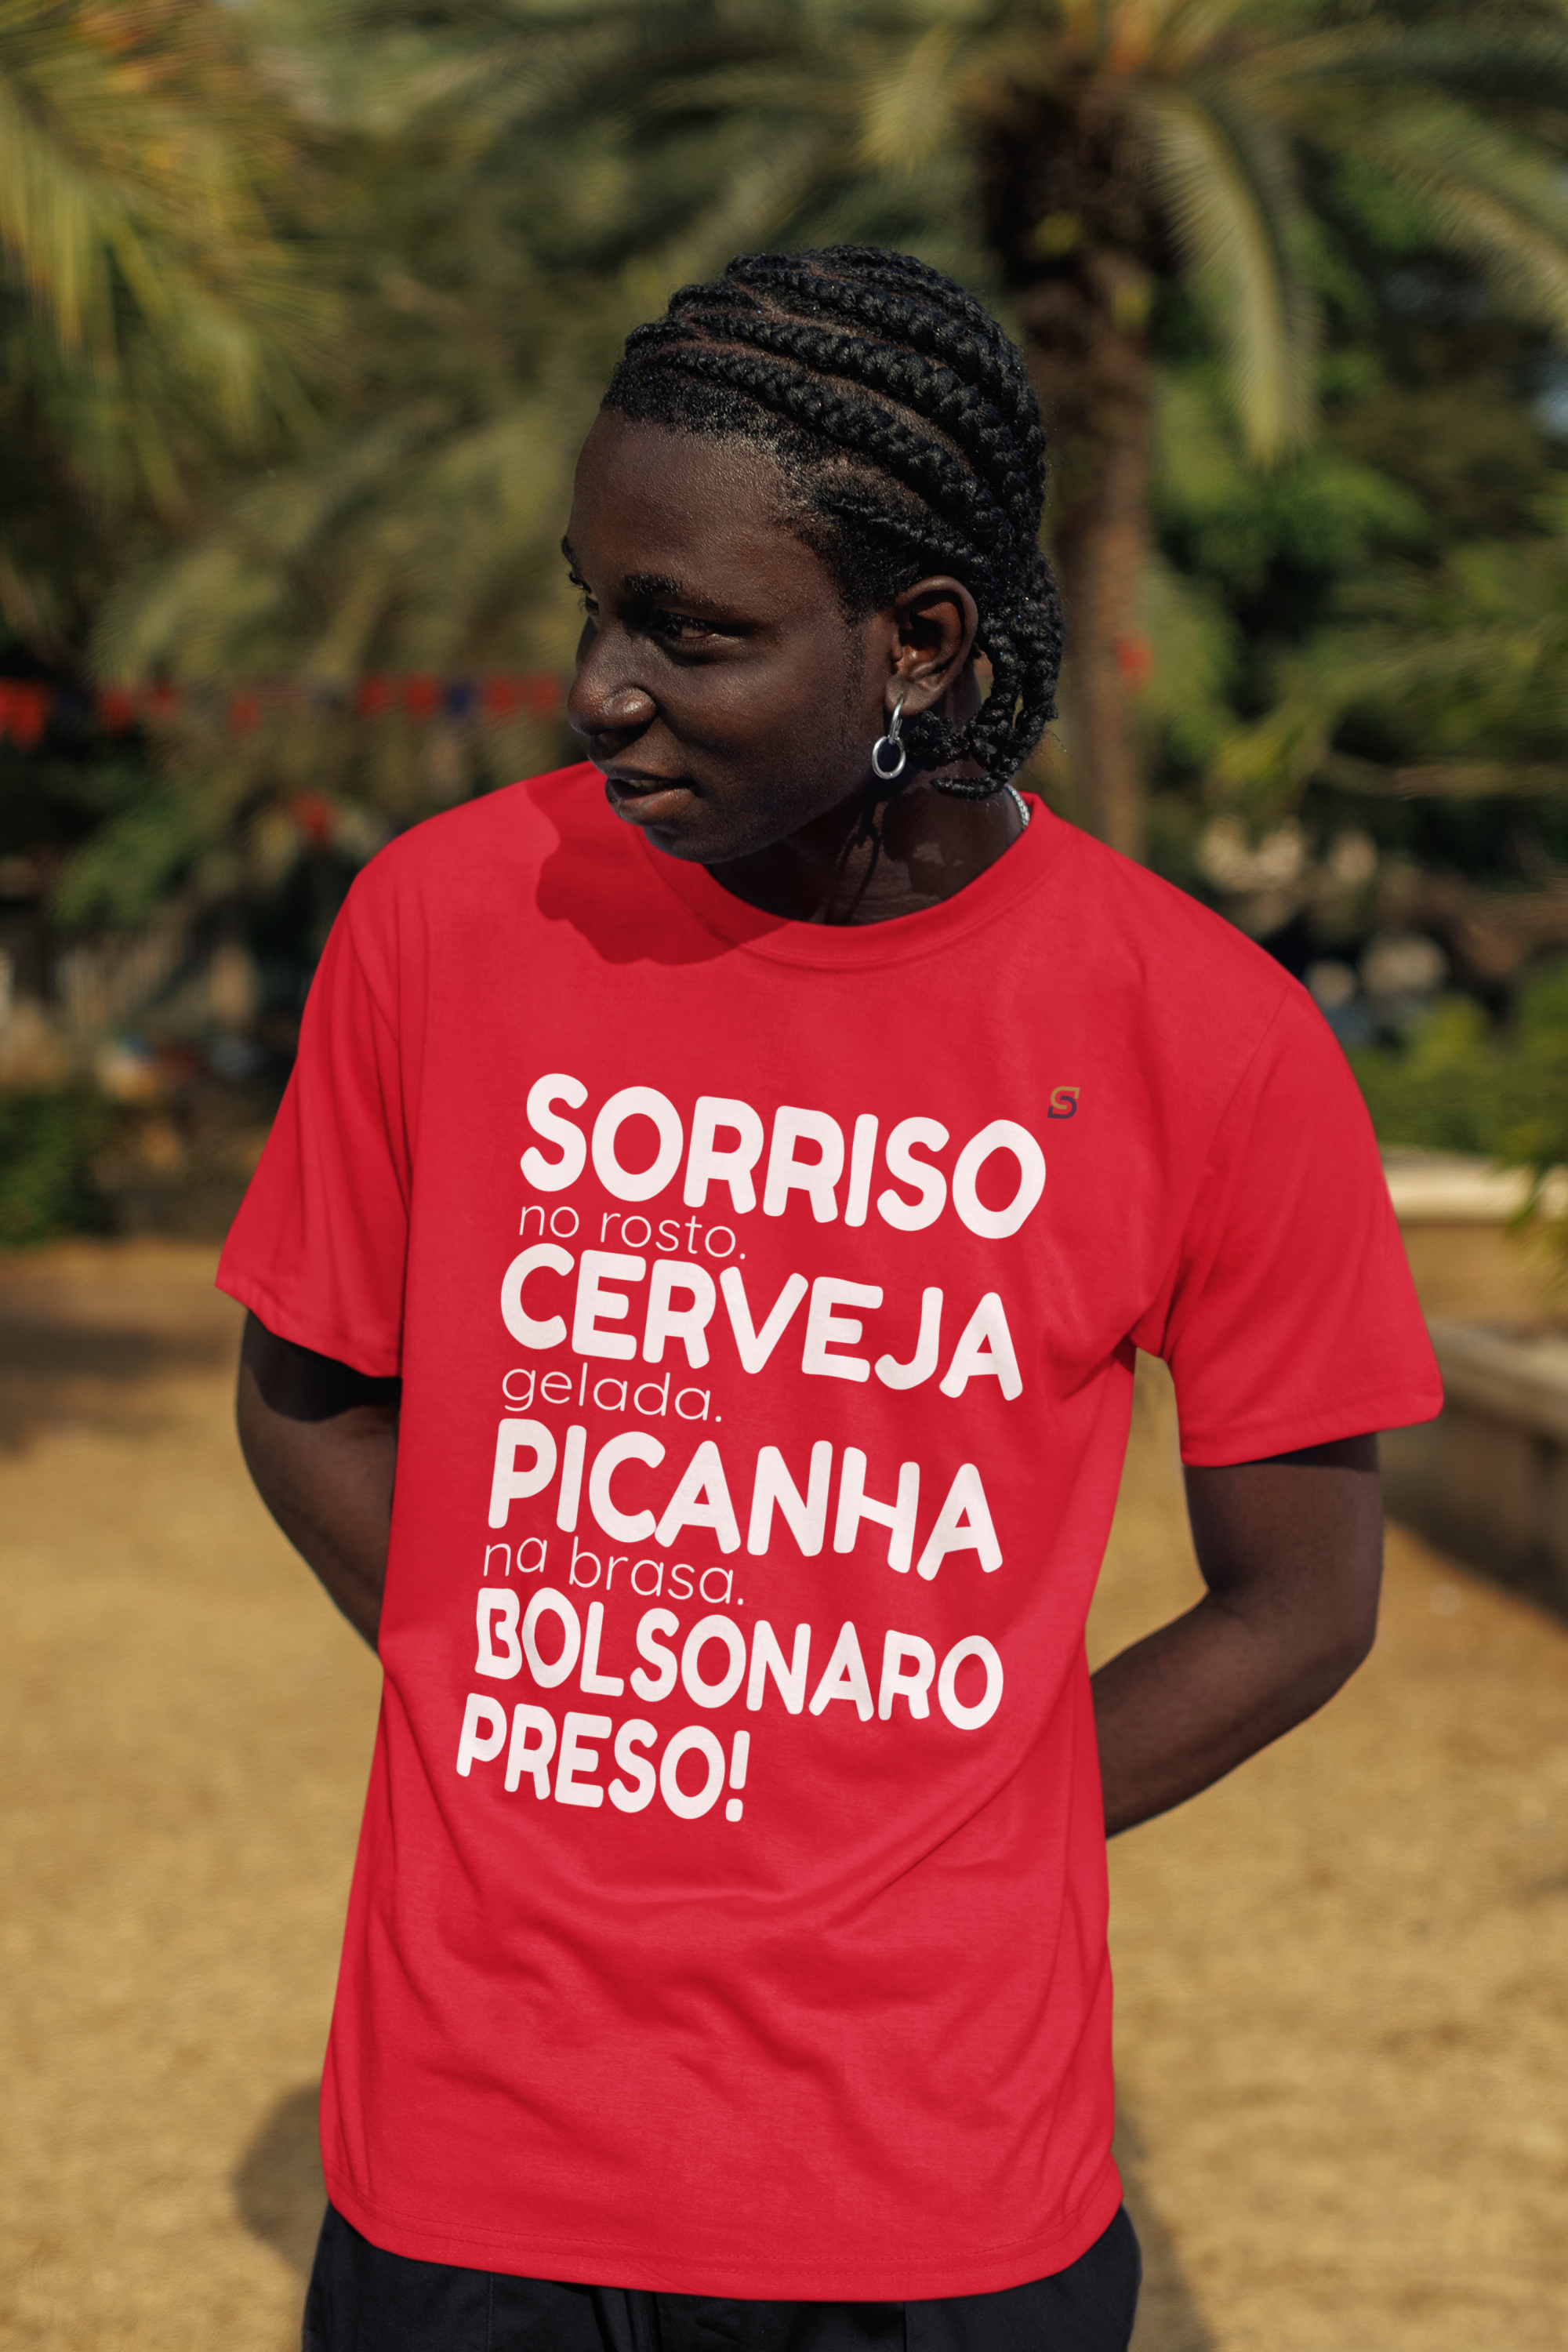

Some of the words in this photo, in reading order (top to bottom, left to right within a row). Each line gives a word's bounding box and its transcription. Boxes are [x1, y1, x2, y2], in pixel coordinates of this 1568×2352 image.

[520, 1073, 1047, 1240] SORRISO
[519, 1205, 579, 1238] no
[600, 1212, 746, 1260] rosto.
[500, 1243, 1023, 1401] CERVEJA
[502, 1362, 722, 1422] gelada.
[488, 1417, 1004, 1581] PICANHA
[483, 1537, 548, 1577] na
[568, 1536, 744, 1606] brasa.
[474, 1587, 1004, 1730] BOLSONARO
[456, 1693, 750, 1823] PRESO!
